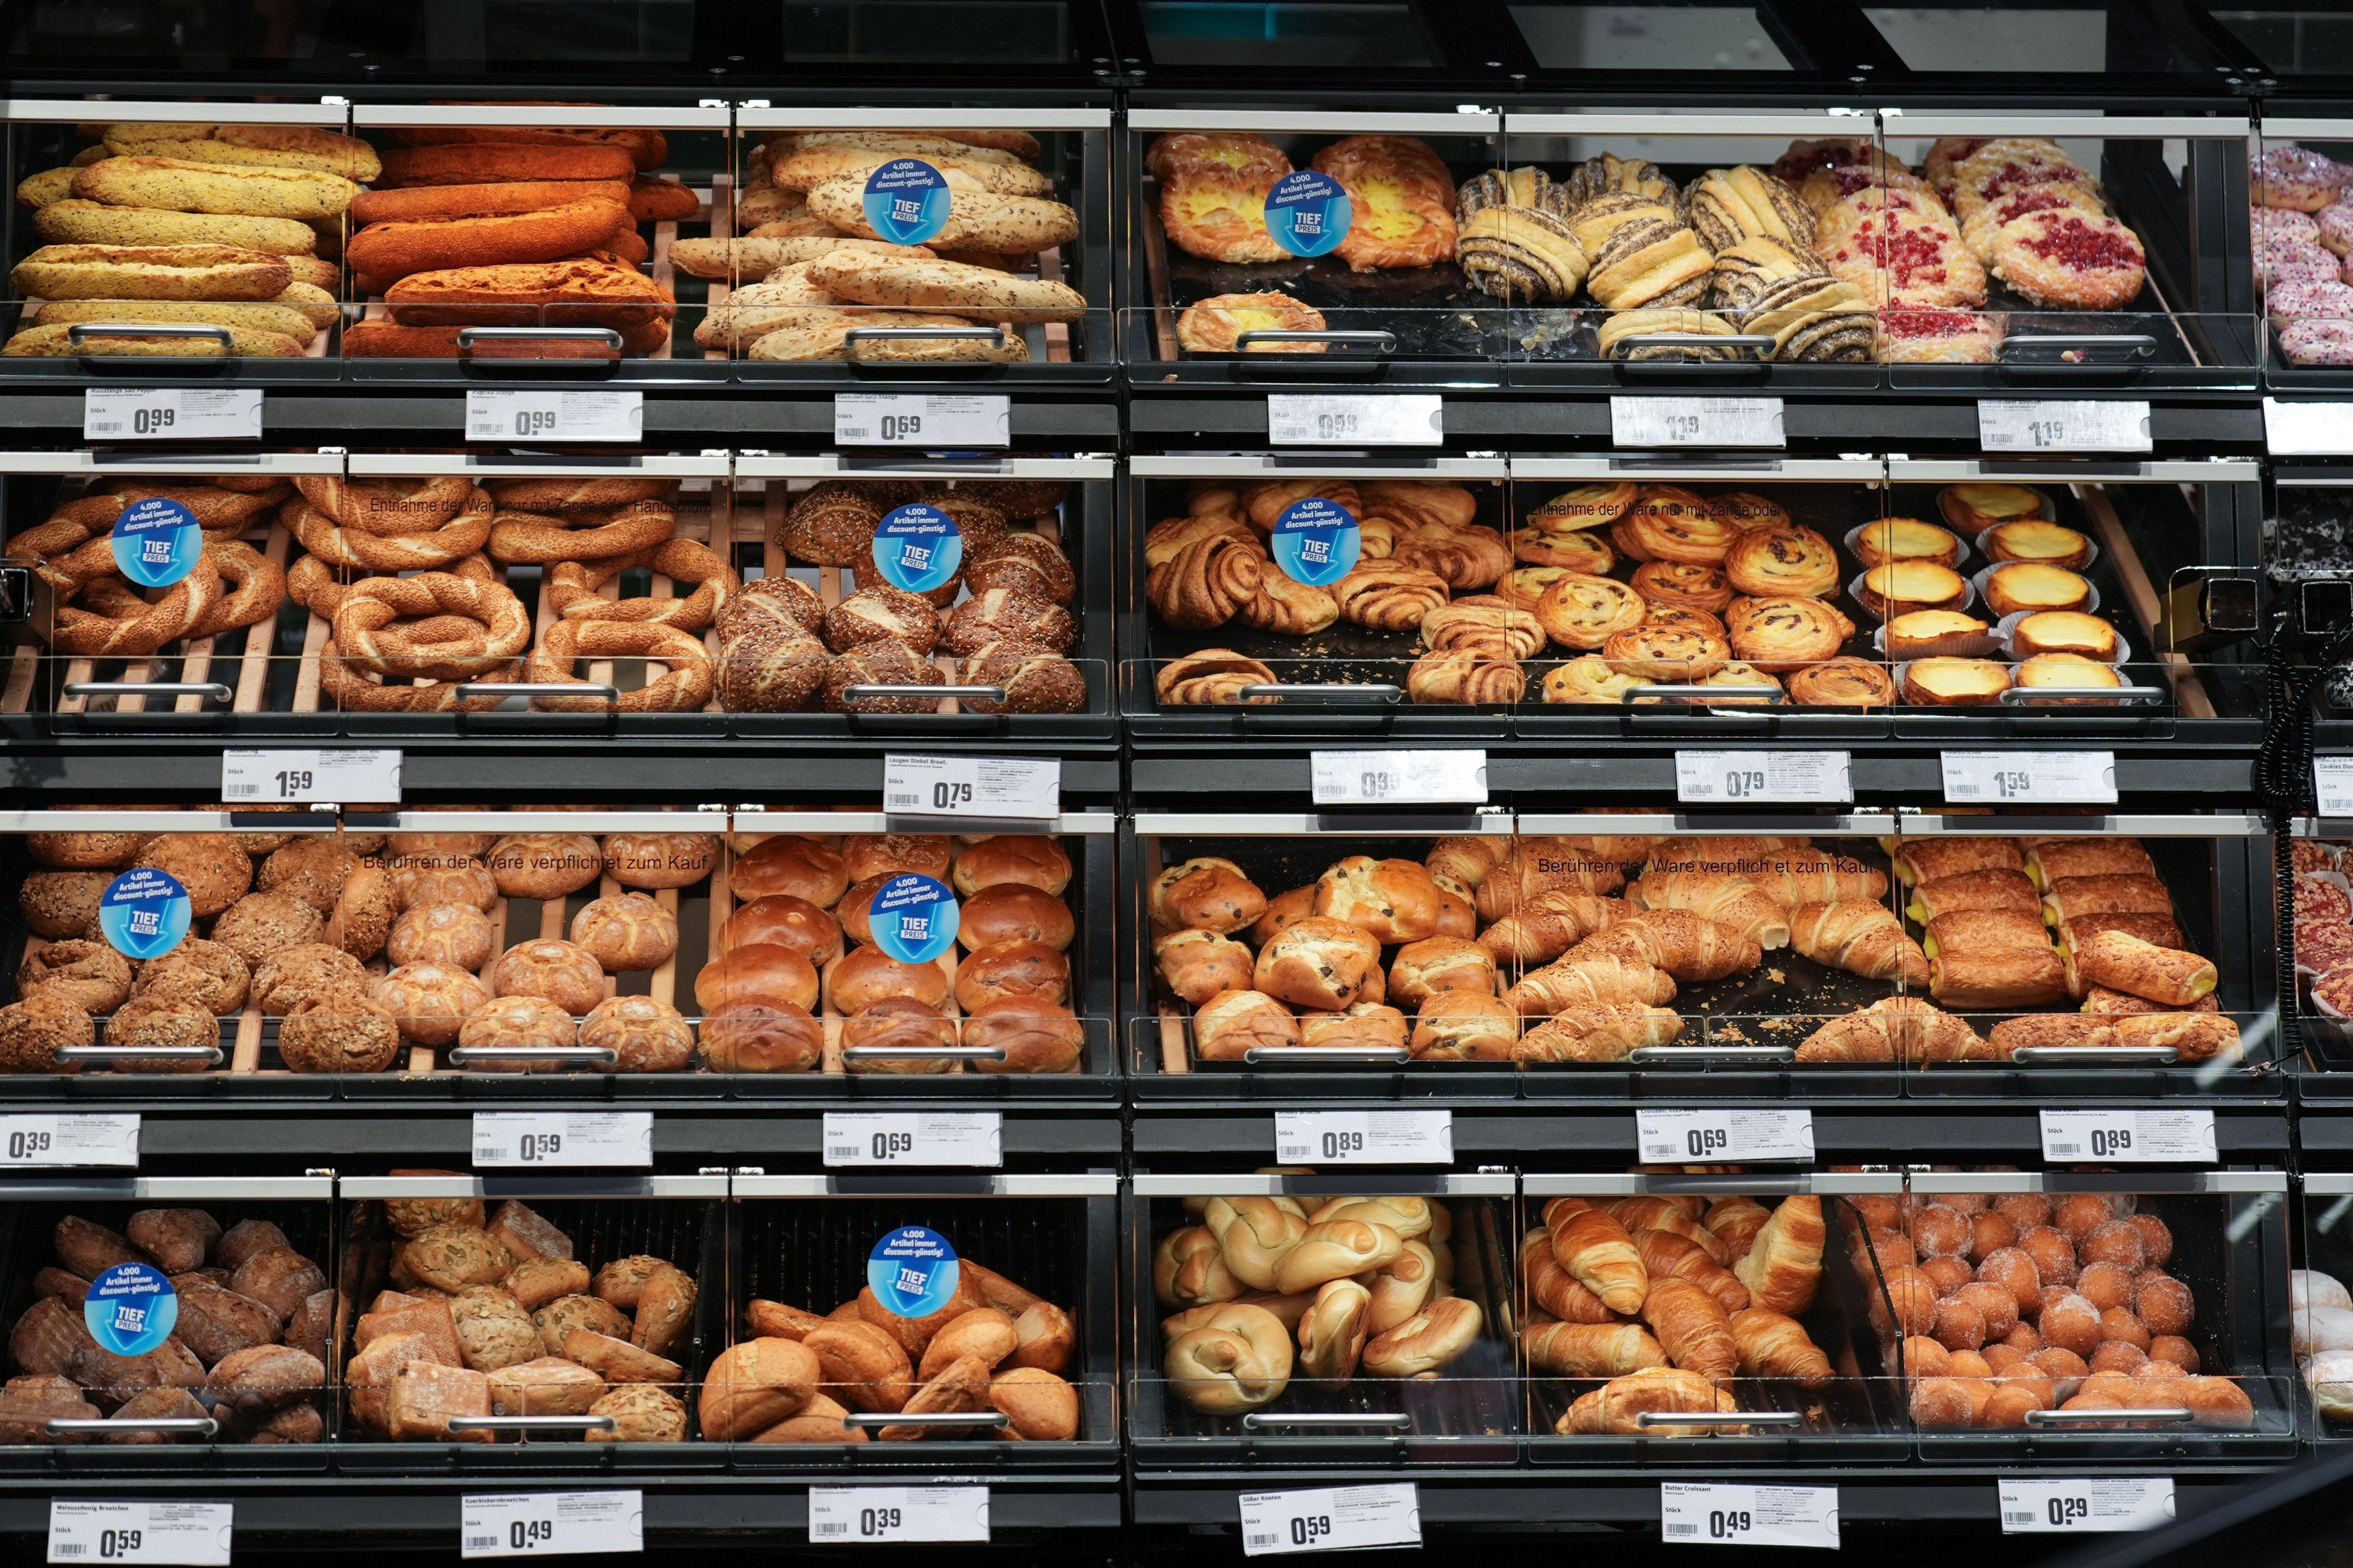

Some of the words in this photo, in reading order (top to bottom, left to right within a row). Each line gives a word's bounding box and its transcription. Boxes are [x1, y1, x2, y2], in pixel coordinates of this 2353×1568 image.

[876, 177, 934, 188] discount-günstig!
[1290, 174, 1311, 184] 4.000
[1275, 187, 1332, 203] discount-günstig!
[1280, 185, 1302, 194] Artikel
[1303, 182, 1324, 190] immer
[895, 199, 920, 213] TIEF
[895, 211, 915, 222] PREIS
[1296, 212, 1321, 225] TIEF
[134, 408, 175, 434] 0.99
[515, 411, 556, 436] 0.99
[881, 415, 921, 441] 0.69
[2028, 421, 2064, 447] 1.19
[140, 501, 162, 511] 4.000
[371, 498, 437, 512] Entnahme
[441, 498, 462, 512] der
[531, 498, 550, 512] mit
[555, 499, 597, 516] Zange
[1302, 502, 1323, 510] 4.000
[1599, 502, 1619, 516] der
[1624, 502, 1657, 516] Ware
[1662, 505, 1682, 516] nur
[1687, 502, 1705, 516] mit
[1709, 502, 1753, 520] Zange
[1754, 502, 1782, 516] oder
[129, 512, 152, 521] Artikel
[1285, 517, 1342, 528] discount-günstig!
[1291, 511, 1314, 519] Artikel
[125, 516, 182, 531] discount-günstig!
[887, 525, 945, 533] discount-günstig!
[145, 541, 171, 553] TIEF
[905, 545, 931, 560] TIEF
[1304, 539, 1330, 554] TIEF
[146, 554, 166, 562] PREIS
[905, 558, 925, 568] PREIS
[1305, 553, 1325, 562] PREIS
[275, 770, 313, 798] 1.59
[1726, 771, 1764, 797] 0.79
[1993, 772, 2030, 798] 1.59
[933, 782, 972, 809] 0.79
[364, 855, 441, 869] Berühren
[447, 855, 474, 869] der
[482, 855, 524, 869] Ware
[529, 855, 621, 872] verpflichtet
[627, 859, 661, 869] zum
[669, 855, 710, 870] Kauf.
[1538, 858, 1613, 873] Berühren
[1620, 858, 1644, 873] der
[1651, 859, 1695, 873] Ware
[1701, 859, 1790, 876] verpflichet
[1795, 863, 1829, 873] zum
[131, 872, 152, 880] 4.000
[896, 878, 918, 888] 4.000
[113, 887, 173, 900] discount-günstig!
[119, 882, 142, 891] Artikel
[886, 889, 909, 899] Artikel
[909, 885, 931, 893] immer
[881, 890, 939, 908] discount-günstig!
[133, 910, 160, 926] TIEF
[902, 917, 928, 930] TIEF
[134, 925, 154, 934] PREIS
[9, 1132, 51, 1159] 0.39
[520, 1134, 561, 1161] 0.59
[872, 1133, 912, 1160] 0.69
[1322, 1132, 1363, 1159] 0.89
[1687, 1129, 1727, 1156] 0.69
[2091, 1129, 2131, 1156] 0.89
[884, 1248, 944, 1257] discount-günstig!
[118, 1267, 140, 1276] 4.000
[901, 1268, 928, 1285] TIEF
[106, 1277, 129, 1286] Artikel
[900, 1283, 920, 1293] PREIS
[99, 1284, 160, 1295] discount-günstig!
[118, 1306, 146, 1322] TIEF
[118, 1319, 139, 1330] PREIS
[2048, 1497, 2088, 1526] 0.29
[861, 1508, 901, 1536] 0.39
[1709, 1510, 1751, 1539] 0.49
[510, 1520, 552, 1549] 0.49
[1291, 1515, 1331, 1545] 0.59
[99, 1530, 142, 1558] 0.59
